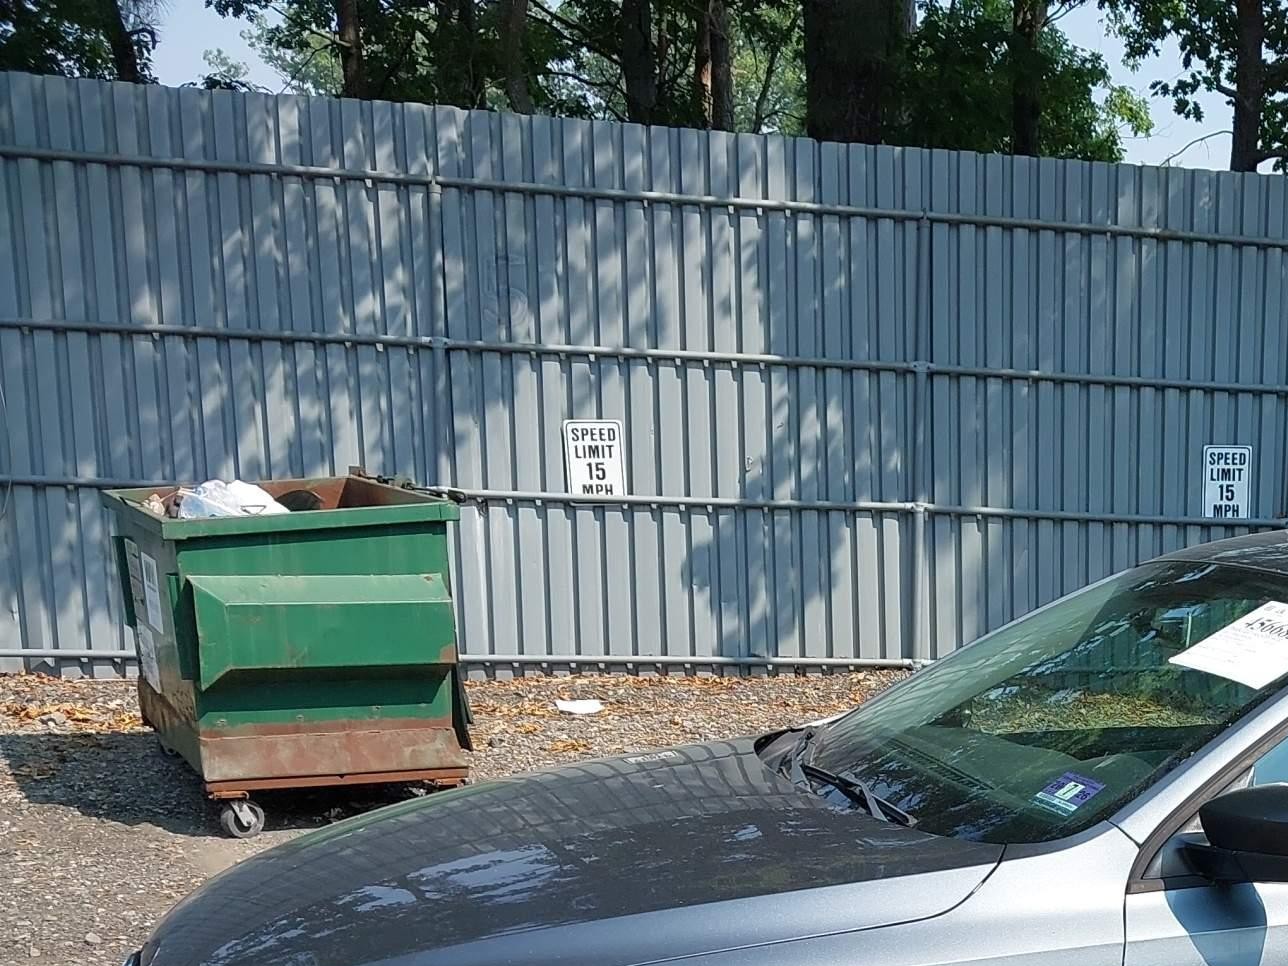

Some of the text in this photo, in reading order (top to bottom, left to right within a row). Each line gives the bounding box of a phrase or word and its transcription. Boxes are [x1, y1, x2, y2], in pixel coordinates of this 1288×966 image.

[571, 428, 616, 441] SPEED
[575, 445, 614, 459] LIMIT
[1209, 452, 1246, 466] SPEED
[587, 462, 606, 480] 15
[1211, 468, 1243, 481] LIMIT
[582, 484, 613, 495] MPH
[1219, 484, 1234, 501] 15
[1213, 504, 1239, 518] MPH
